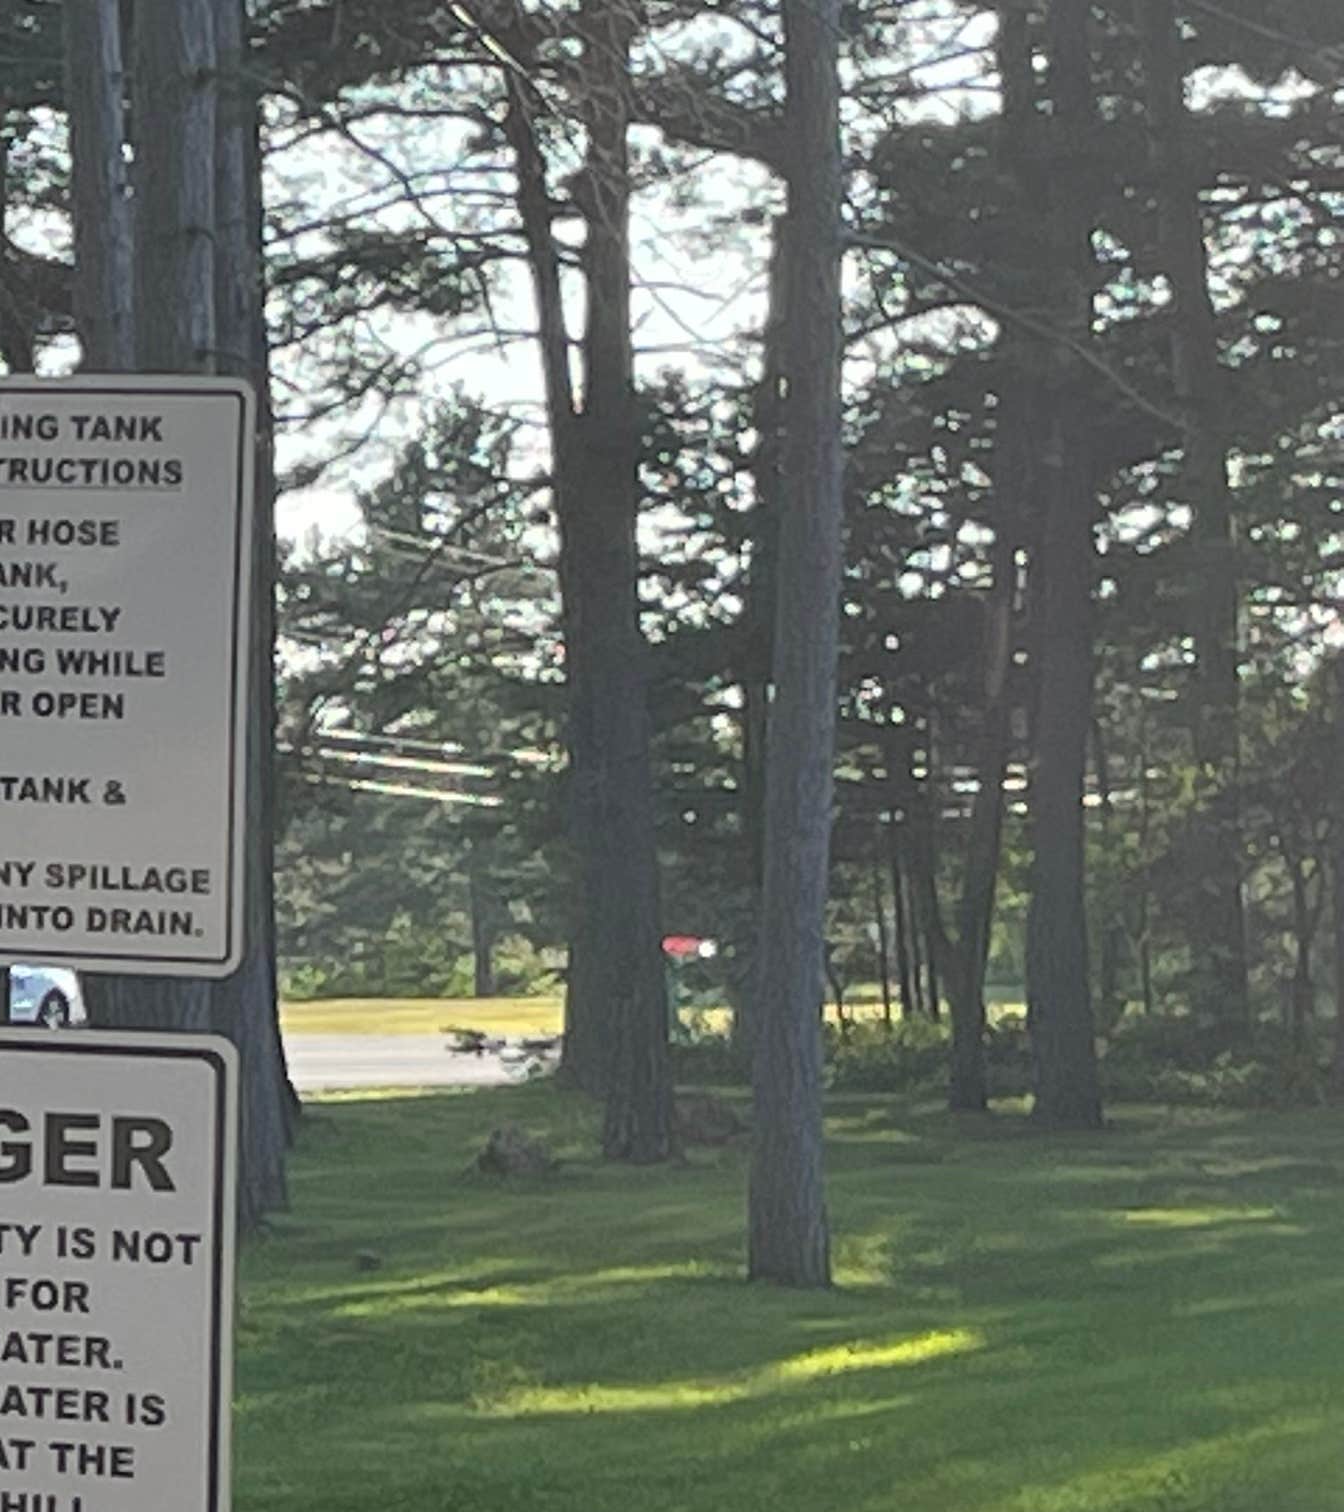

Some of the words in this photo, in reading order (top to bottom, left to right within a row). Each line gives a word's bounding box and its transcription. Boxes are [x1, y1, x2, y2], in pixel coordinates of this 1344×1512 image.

[70, 415, 163, 442] TANK
[27, 519, 120, 547] HOSE
[56, 648, 165, 678] WHILE
[31, 691, 124, 720] OPEN
[102, 779, 127, 806] &
[45, 863, 210, 895] SPILLAGE
[86, 906, 203, 937] DRAIN.
[57, 1226, 96, 1259] IS
[112, 1230, 201, 1266] NOT
[5, 1278, 90, 1314] FOR
[126, 1393, 166, 1426] IS
[48, 1442, 134, 1479] THE
